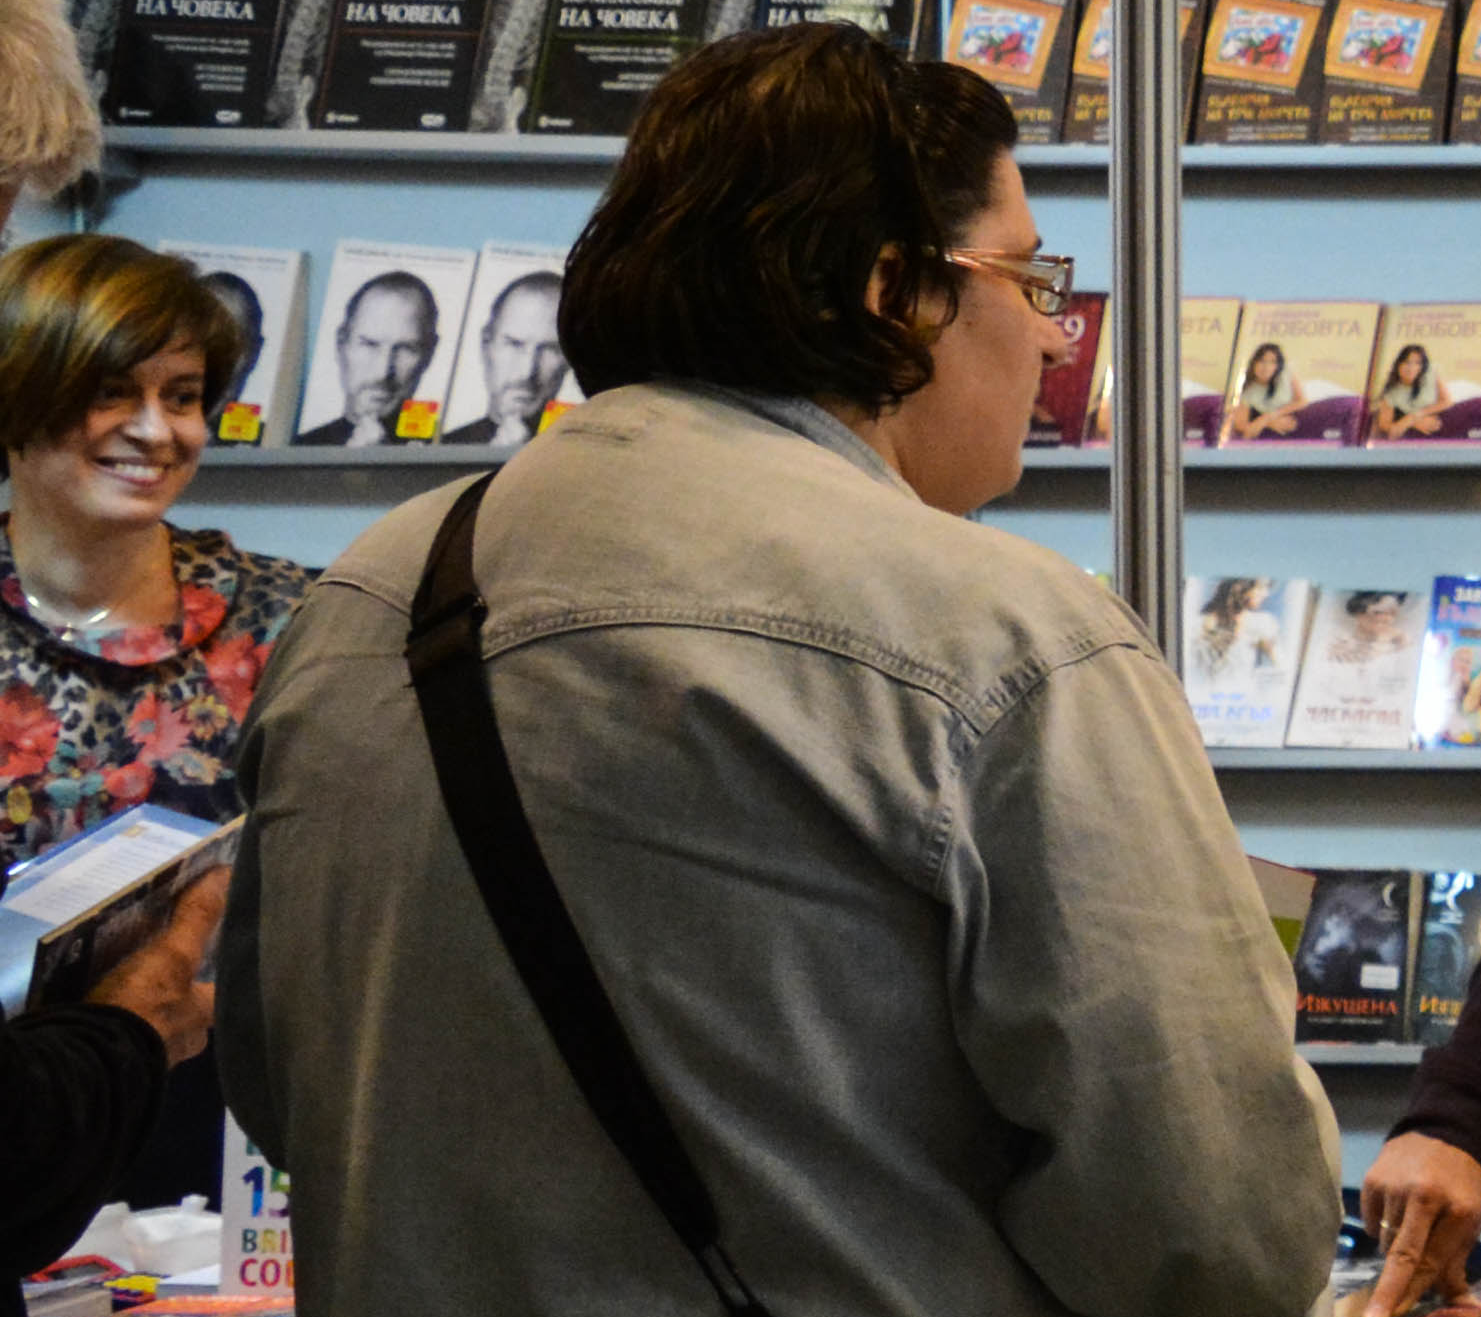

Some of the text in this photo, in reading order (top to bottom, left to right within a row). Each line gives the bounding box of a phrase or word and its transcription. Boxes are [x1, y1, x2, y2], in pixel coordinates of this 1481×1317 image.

[347, 4, 462, 25] НА ЧОВЕКА
[559, 9, 680, 30] НА ЧОВЕКА
[1250, 318, 1363, 338] ЛЮБОВТА
